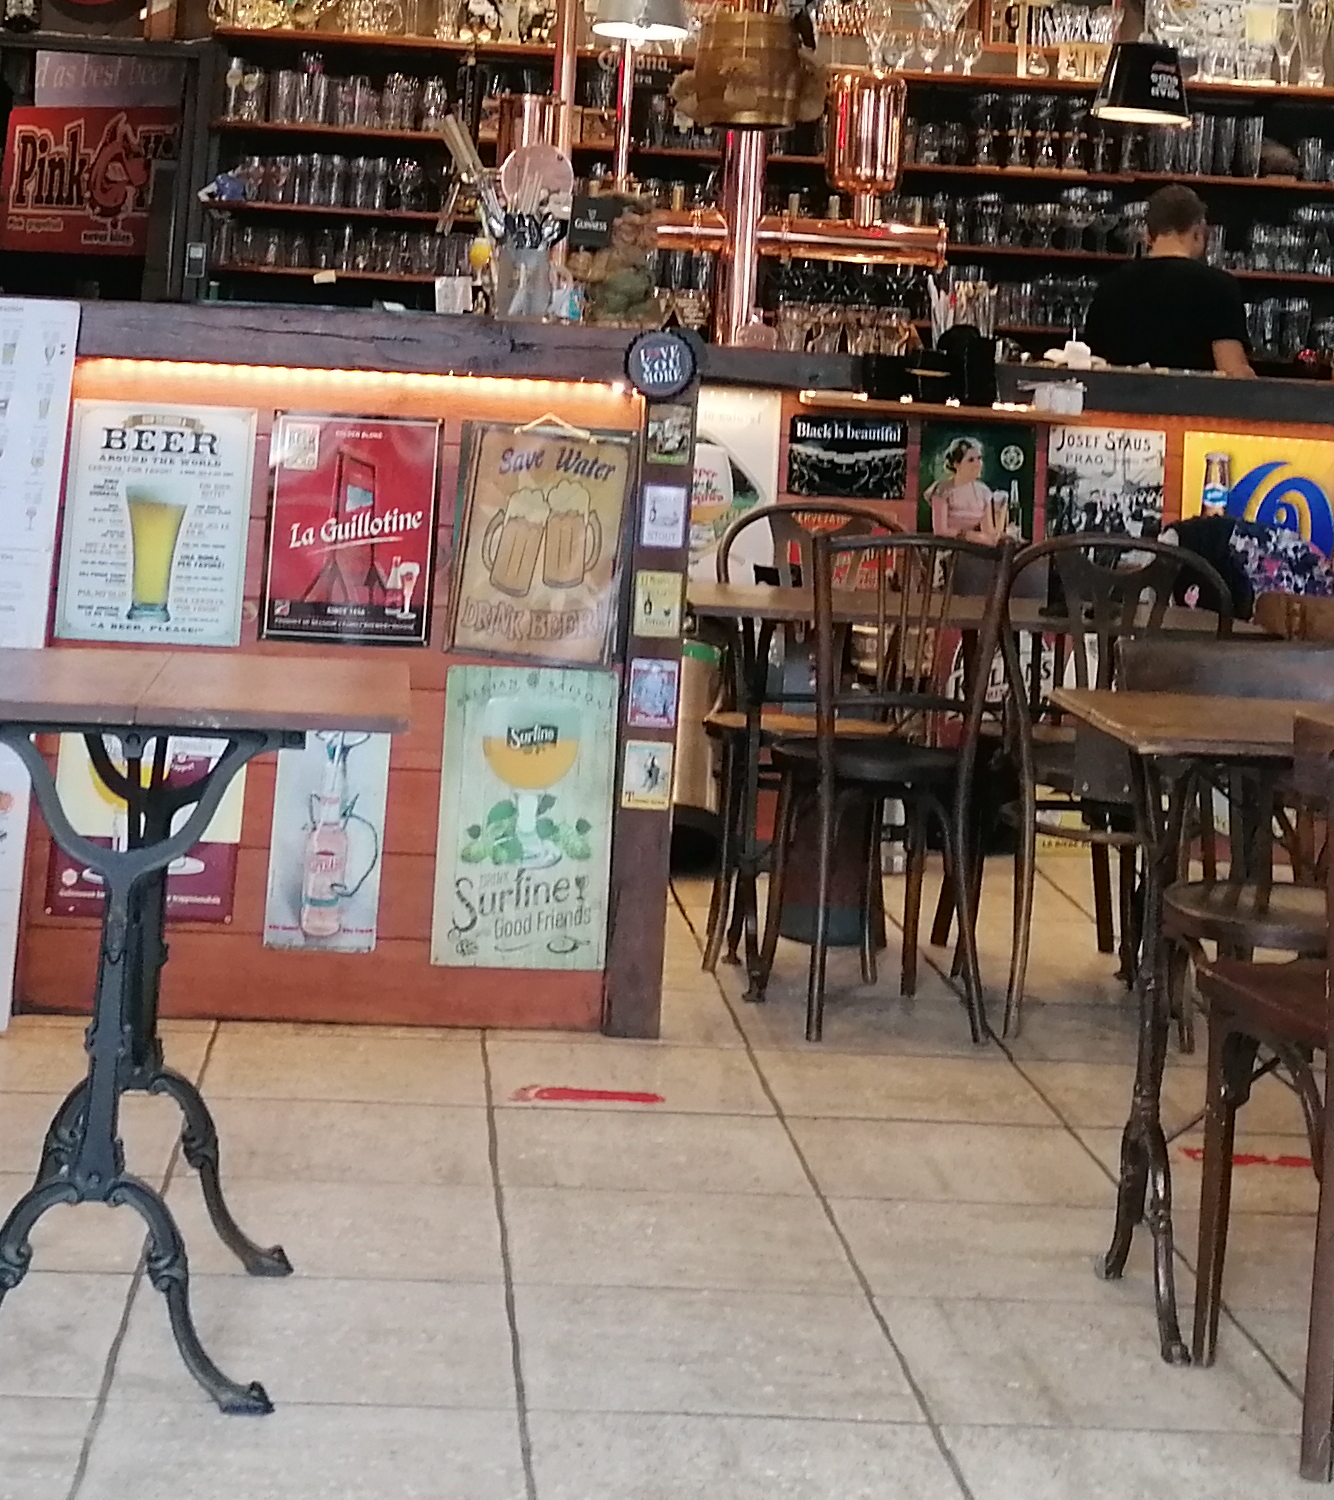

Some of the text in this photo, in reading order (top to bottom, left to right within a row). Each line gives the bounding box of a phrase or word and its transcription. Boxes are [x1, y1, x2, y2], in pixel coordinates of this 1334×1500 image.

[10, 122, 91, 212] Pink
[101, 427, 218, 456] BEER
[796, 423, 833, 441] Black
[846, 424, 903, 443] beautiful
[1056, 429, 1152, 452] JOSEF STAUS
[499, 446, 616, 481] Save Water
[289, 507, 423, 549] La Guillotine
[447, 868, 571, 943] Surfine
[494, 904, 592, 940] Good Friends
